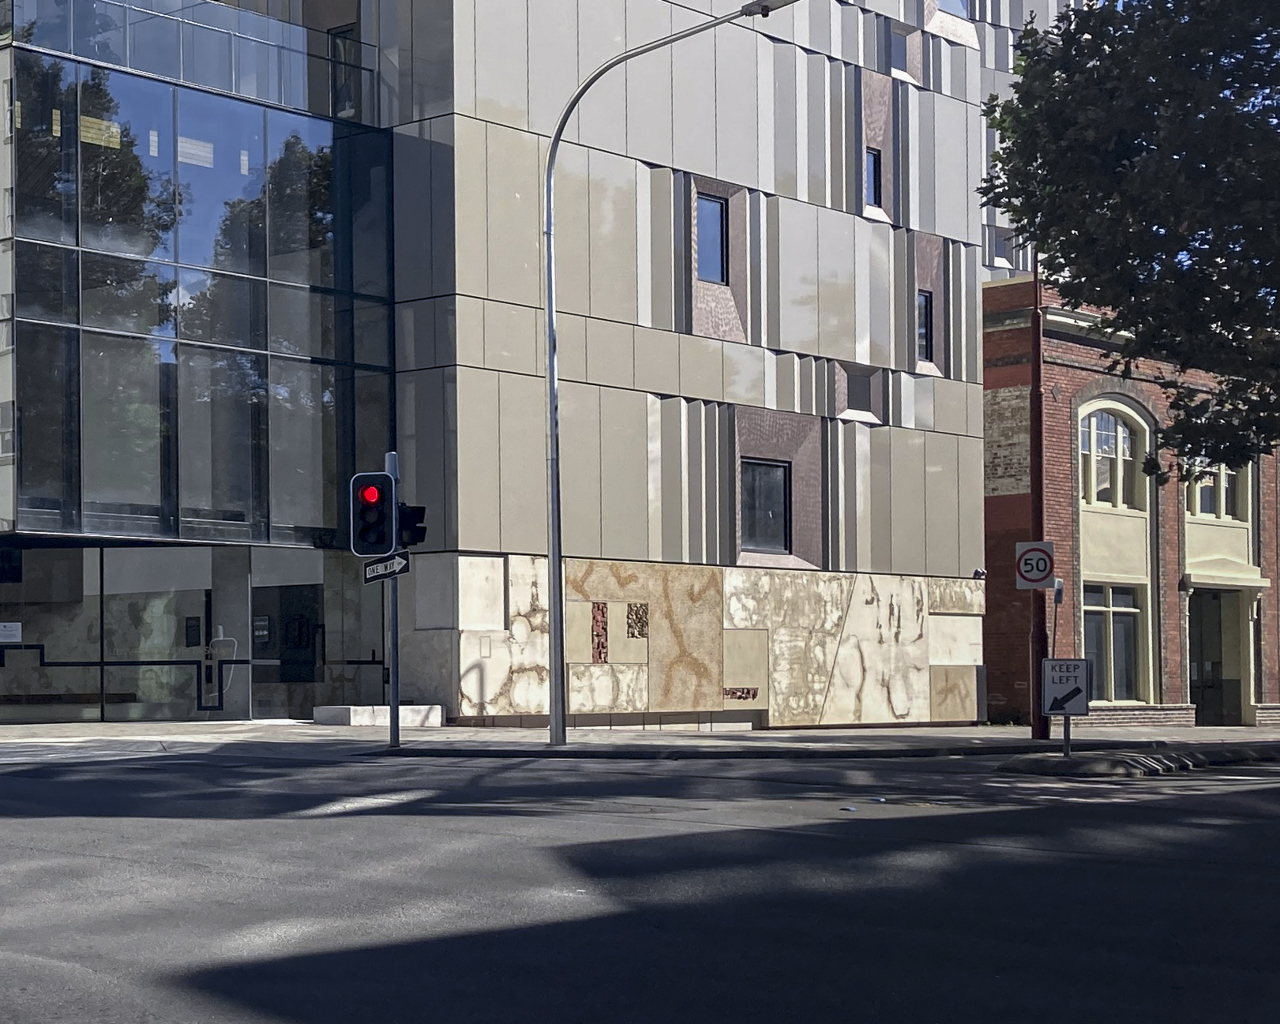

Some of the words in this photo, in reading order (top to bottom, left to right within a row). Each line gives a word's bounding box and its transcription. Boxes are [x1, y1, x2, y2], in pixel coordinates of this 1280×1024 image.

[368, 565, 380, 576] ONE
[384, 561, 396, 572] WAY
[1023, 557, 1048, 574] 50
[1051, 663, 1080, 673] KEEP
[1051, 675, 1079, 685] LEFT
